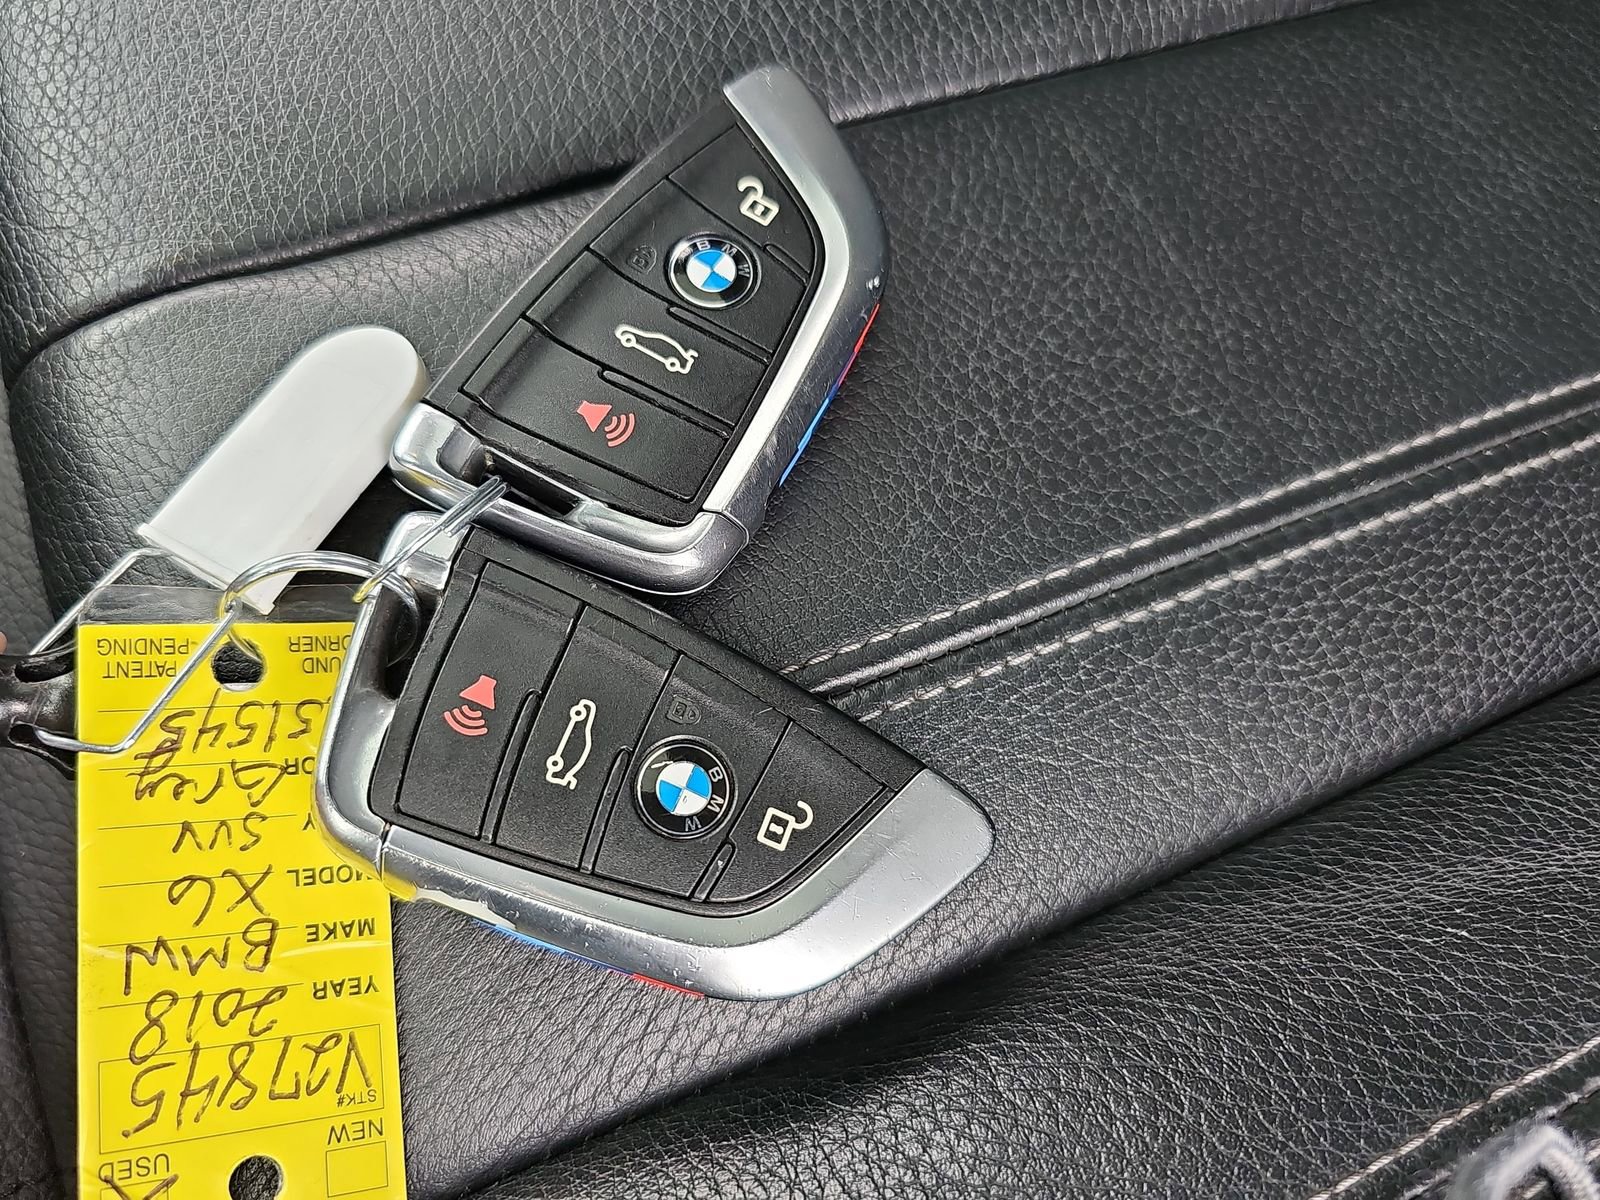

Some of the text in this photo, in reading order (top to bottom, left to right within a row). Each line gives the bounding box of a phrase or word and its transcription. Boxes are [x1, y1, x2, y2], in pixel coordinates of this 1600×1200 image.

[695, 240, 750, 278] BMW
[96, 638, 190, 656] PENDING
[288, 635, 352, 652] ORNER
[102, 660, 177, 679] PATENT
[302, 656, 342, 674] UND
[684, 766, 725, 832] BMW
[172, 812, 268, 853] SUV
[168, 863, 273, 928] X6
[305, 917, 376, 943] MAKE
[123, 918, 280, 996] BMW
[312, 974, 379, 1000] YEAR
[129, 986, 289, 1065] 2018
[121, 1031, 373, 1138] V27845
[336, 1088, 377, 1107] STK#
[327, 1117, 384, 1145] NEW
[98, 1153, 170, 1183] USED
